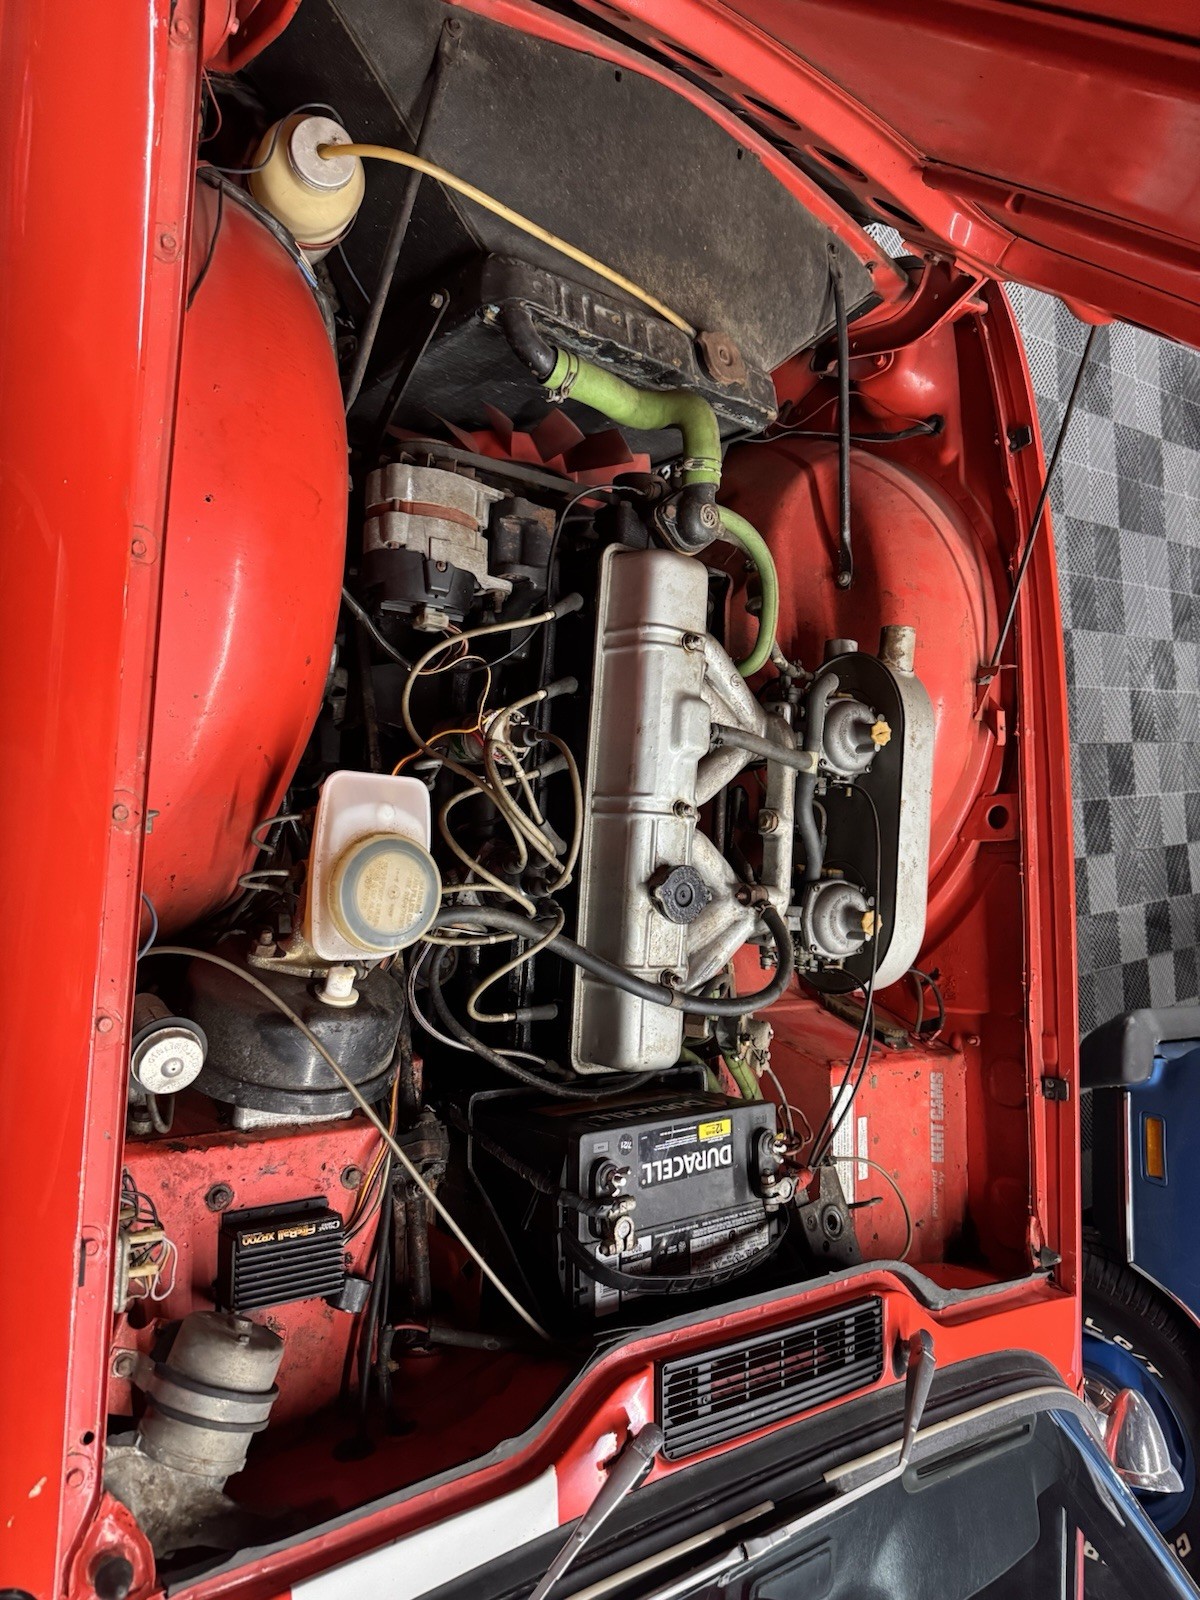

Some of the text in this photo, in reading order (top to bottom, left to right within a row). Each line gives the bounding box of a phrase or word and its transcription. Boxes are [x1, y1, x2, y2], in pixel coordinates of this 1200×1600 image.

[715, 1123, 723, 1134] 12
[930, 1072, 944, 1163] KENT CAMS
[620, 1140, 632, 1149] 7/21
[641, 1144, 732, 1184] DURACELL
[931, 1169, 939, 1218] Powered
